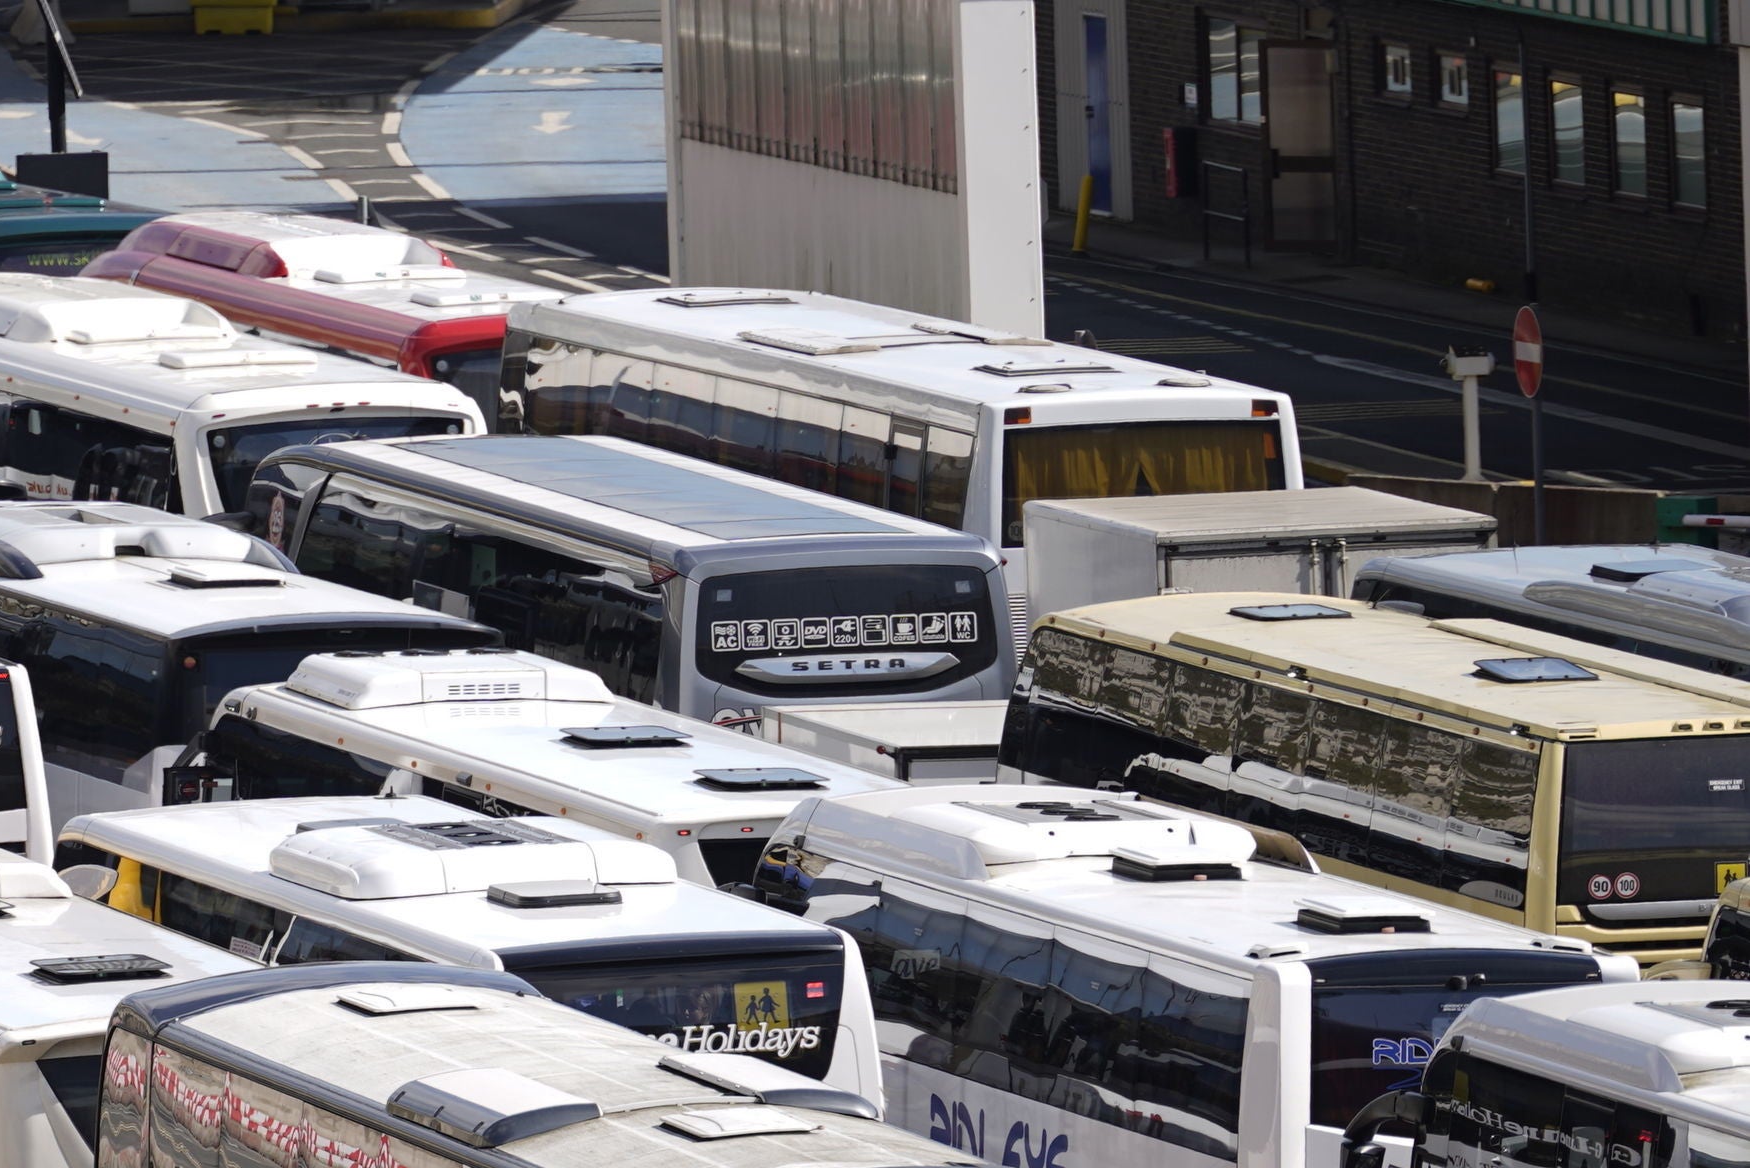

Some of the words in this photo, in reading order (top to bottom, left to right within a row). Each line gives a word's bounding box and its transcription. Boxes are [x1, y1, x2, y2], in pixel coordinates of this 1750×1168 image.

[804, 625, 827, 635] DVD
[956, 631, 971, 640] WC
[716, 638, 738, 647] AC
[834, 634, 856, 644] 220v
[792, 657, 906, 671] SETRA
[1593, 880, 1608, 893] 90
[1619, 879, 1635, 892] 100
[682, 1022, 821, 1058] Holidays
